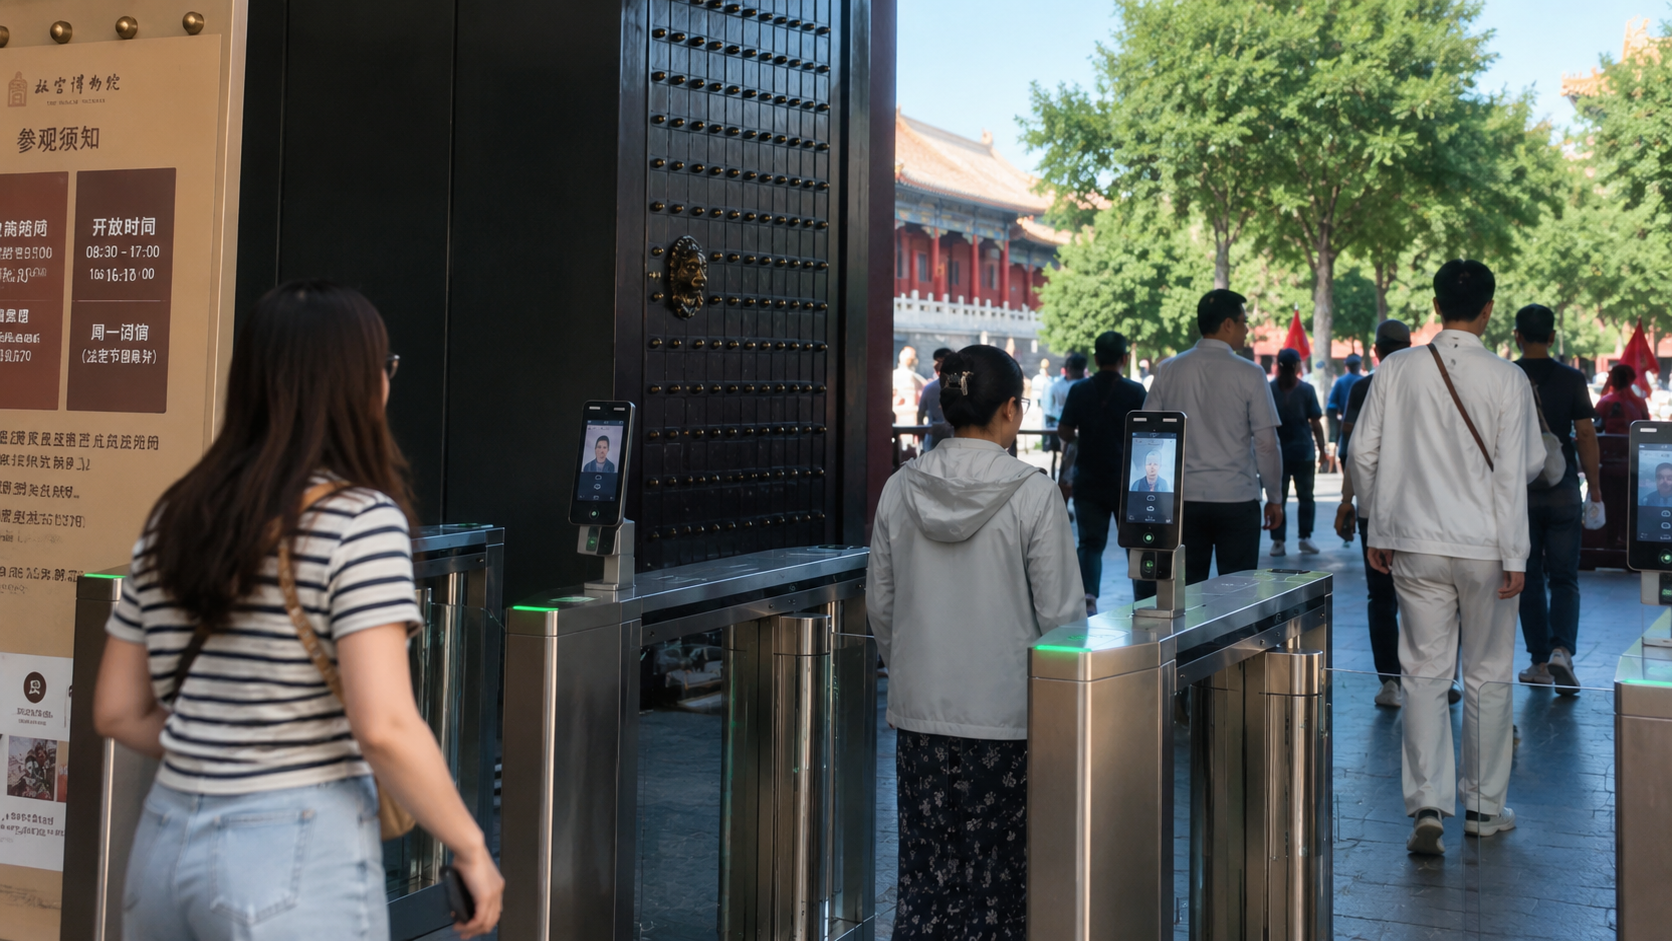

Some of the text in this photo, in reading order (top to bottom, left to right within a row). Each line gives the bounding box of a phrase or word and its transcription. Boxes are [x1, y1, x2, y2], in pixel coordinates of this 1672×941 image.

[16, 125, 100, 154] 参观须知
[86, 245, 118, 259] 08:30
[130, 245, 160, 258] 17:00
